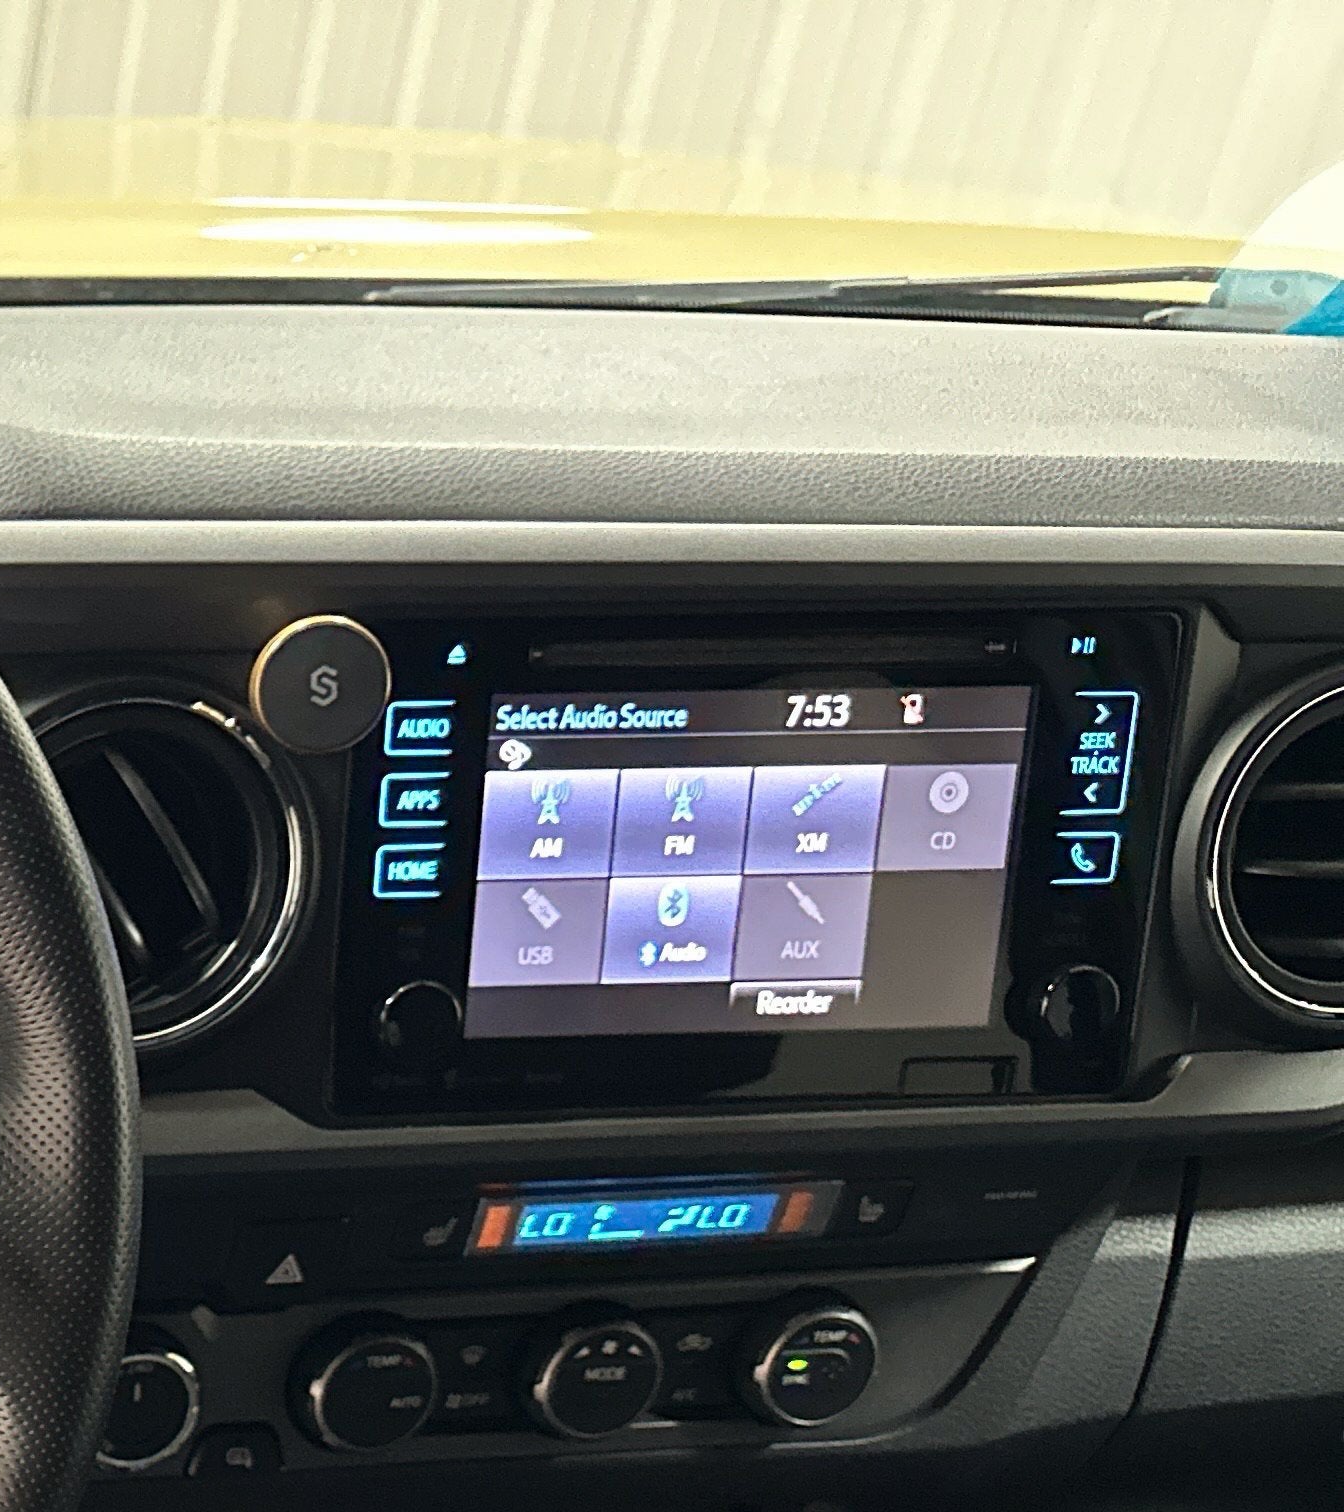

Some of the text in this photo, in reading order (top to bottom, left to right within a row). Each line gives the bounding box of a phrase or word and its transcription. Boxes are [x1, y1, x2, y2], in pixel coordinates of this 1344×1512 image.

[495, 694, 852, 731] Select Audio Source 7:53
[397, 717, 451, 739] AUDIO
[1079, 731, 1117, 751] SEEK
[1070, 755, 1121, 775] TRACK
[396, 789, 441, 811] APPS
[529, 837, 563, 859] AM
[664, 834, 696, 856] FM
[795, 832, 830, 853] XM
[930, 831, 957, 851] CD
[387, 860, 439, 881] HOME
[517, 945, 554, 966] USB
[658, 941, 708, 963] Audio
[780, 939, 821, 960] AUX
[755, 990, 834, 1016] Reorder
